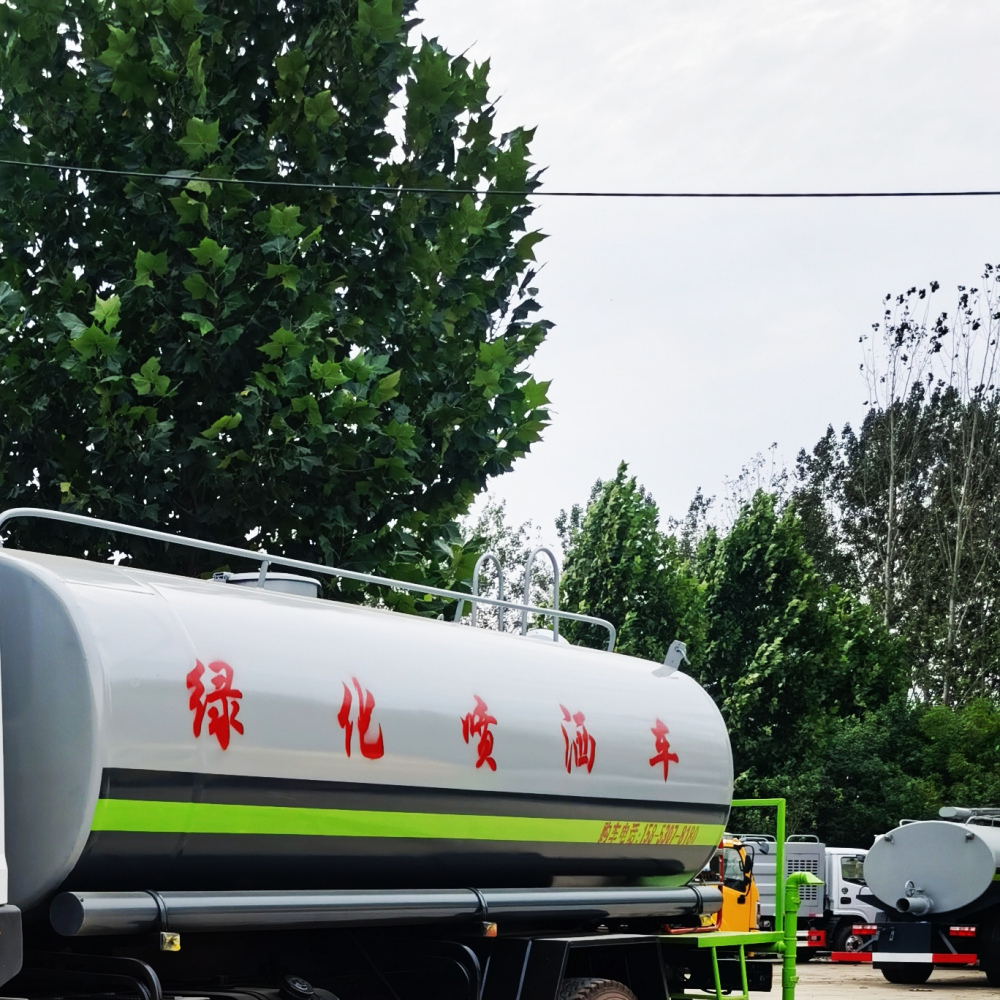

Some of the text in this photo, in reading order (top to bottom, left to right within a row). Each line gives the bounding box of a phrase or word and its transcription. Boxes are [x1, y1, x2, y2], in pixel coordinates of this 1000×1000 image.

[186, 658, 680, 783] 绿化喷洒车
